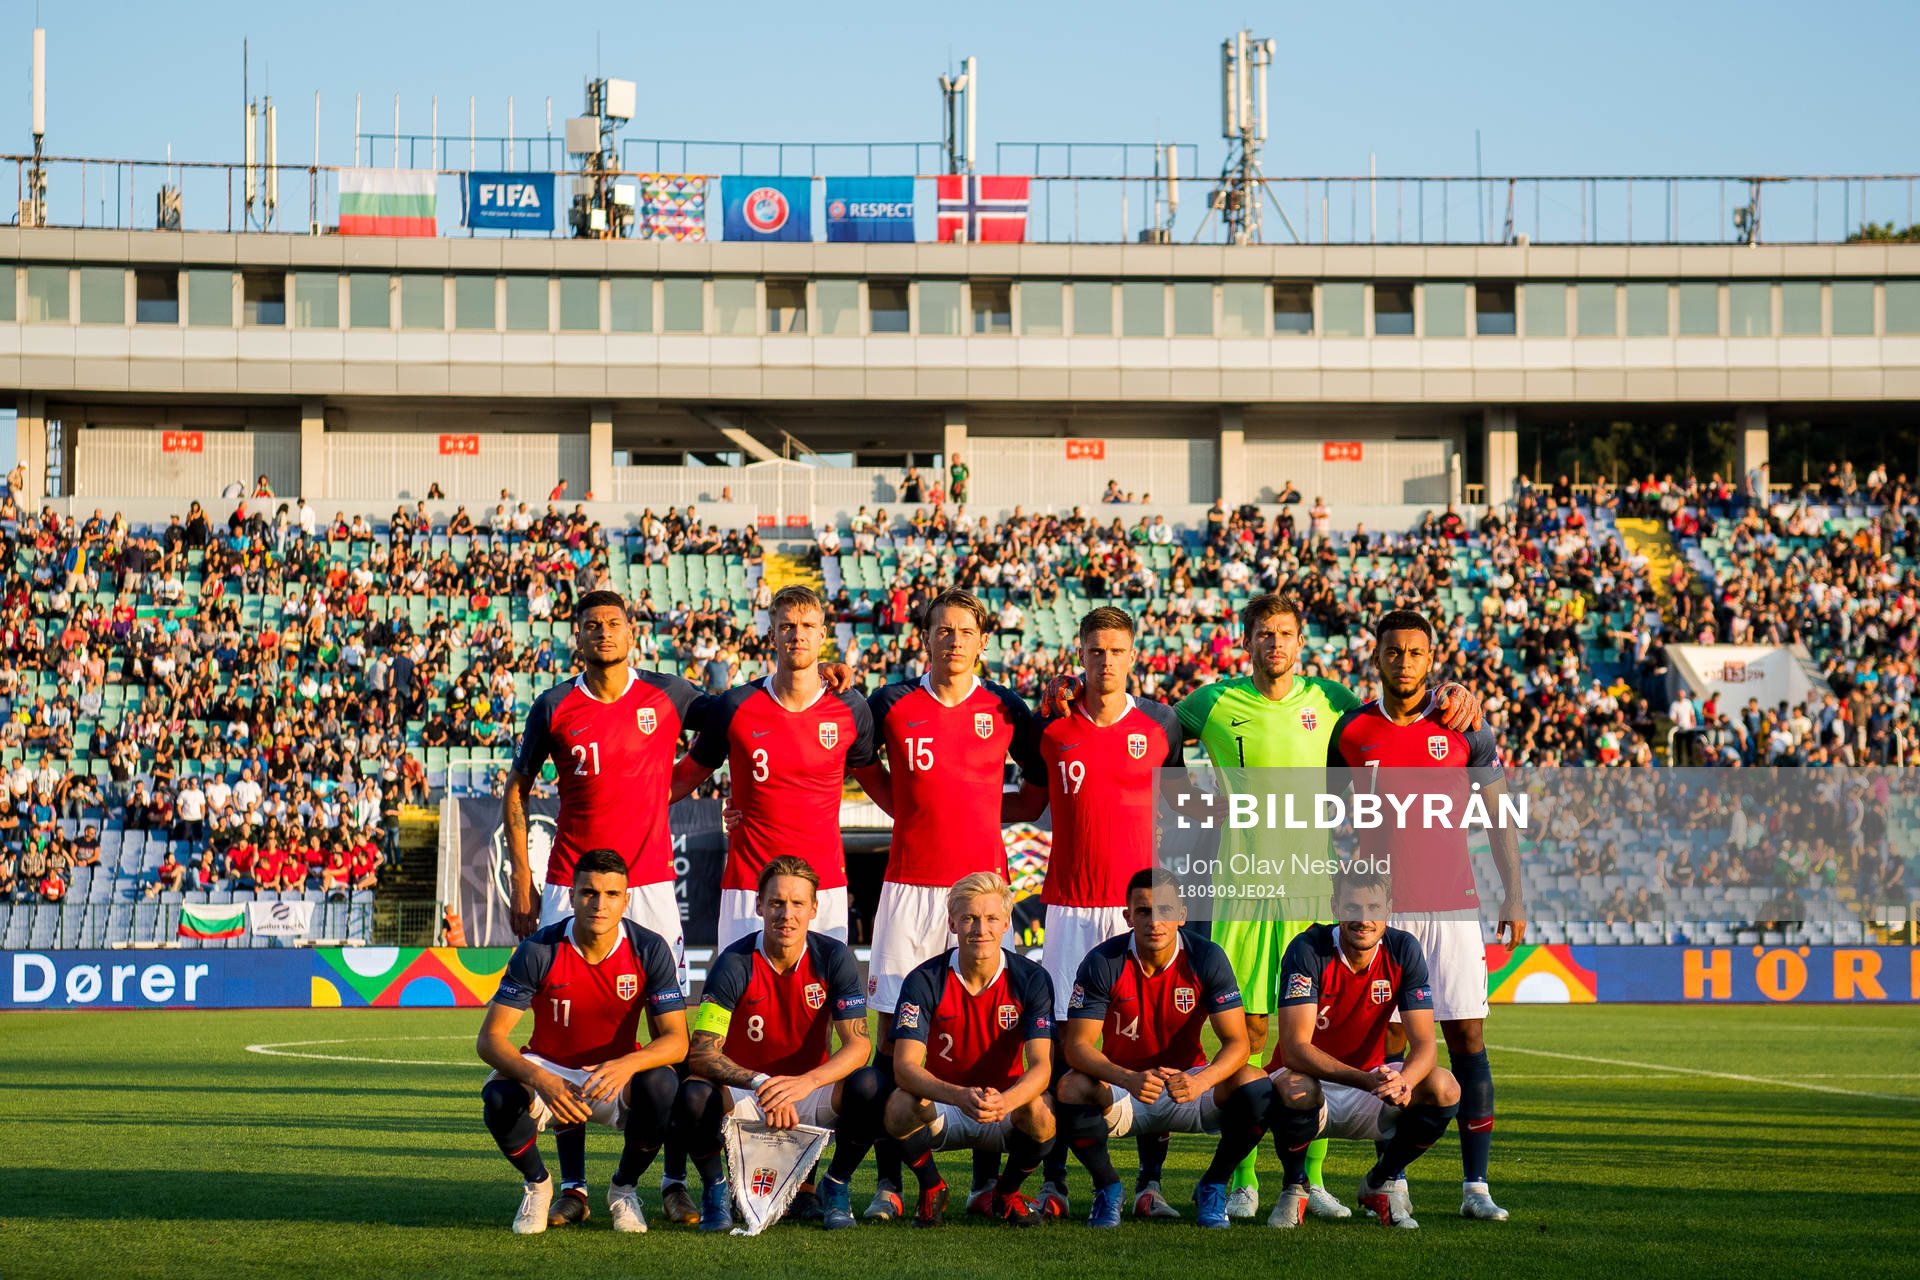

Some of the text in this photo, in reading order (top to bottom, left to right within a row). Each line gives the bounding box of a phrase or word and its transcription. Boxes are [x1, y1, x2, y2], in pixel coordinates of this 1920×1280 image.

[480, 184, 540, 208] FIFA
[850, 202, 913, 218] RESPECT
[571, 742, 600, 776] 21
[752, 748, 769, 782] 3
[904, 737, 934, 771] 15
[1235, 736, 1245, 768] 1
[1057, 760, 1086, 794] 19
[1364, 760, 1381, 794] 7
[13, 953, 209, 1004] Dører
[550, 998, 571, 1028] 11
[747, 1015, 765, 1042] 8
[1113, 1011, 1140, 1041] 14
[1315, 1005, 1331, 1030] 6
[938, 1032, 953, 1062] 2
